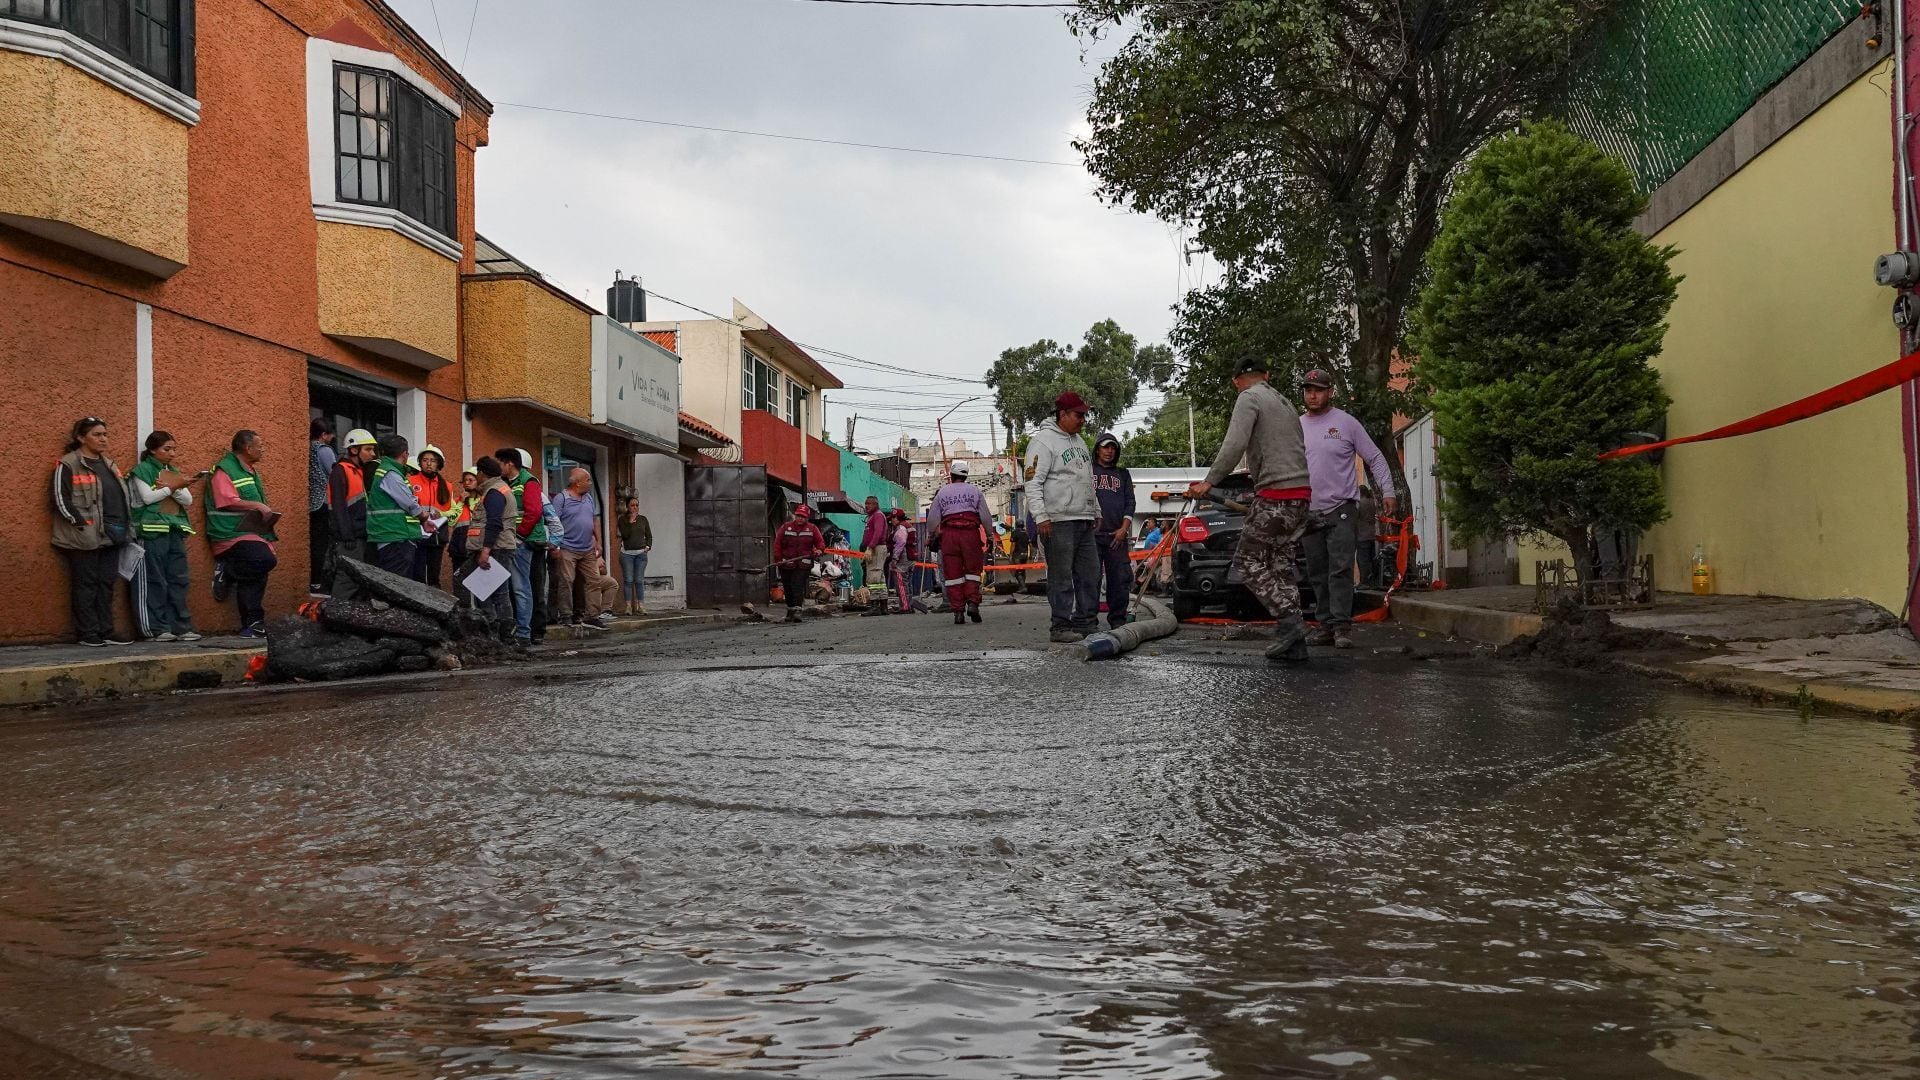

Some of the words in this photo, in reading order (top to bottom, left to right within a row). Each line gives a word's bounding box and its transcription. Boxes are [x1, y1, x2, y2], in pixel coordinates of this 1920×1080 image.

[632, 369, 647, 392] VIDA
[1061, 447, 1075, 466] NEW
[1092, 474, 1121, 493] GAP
